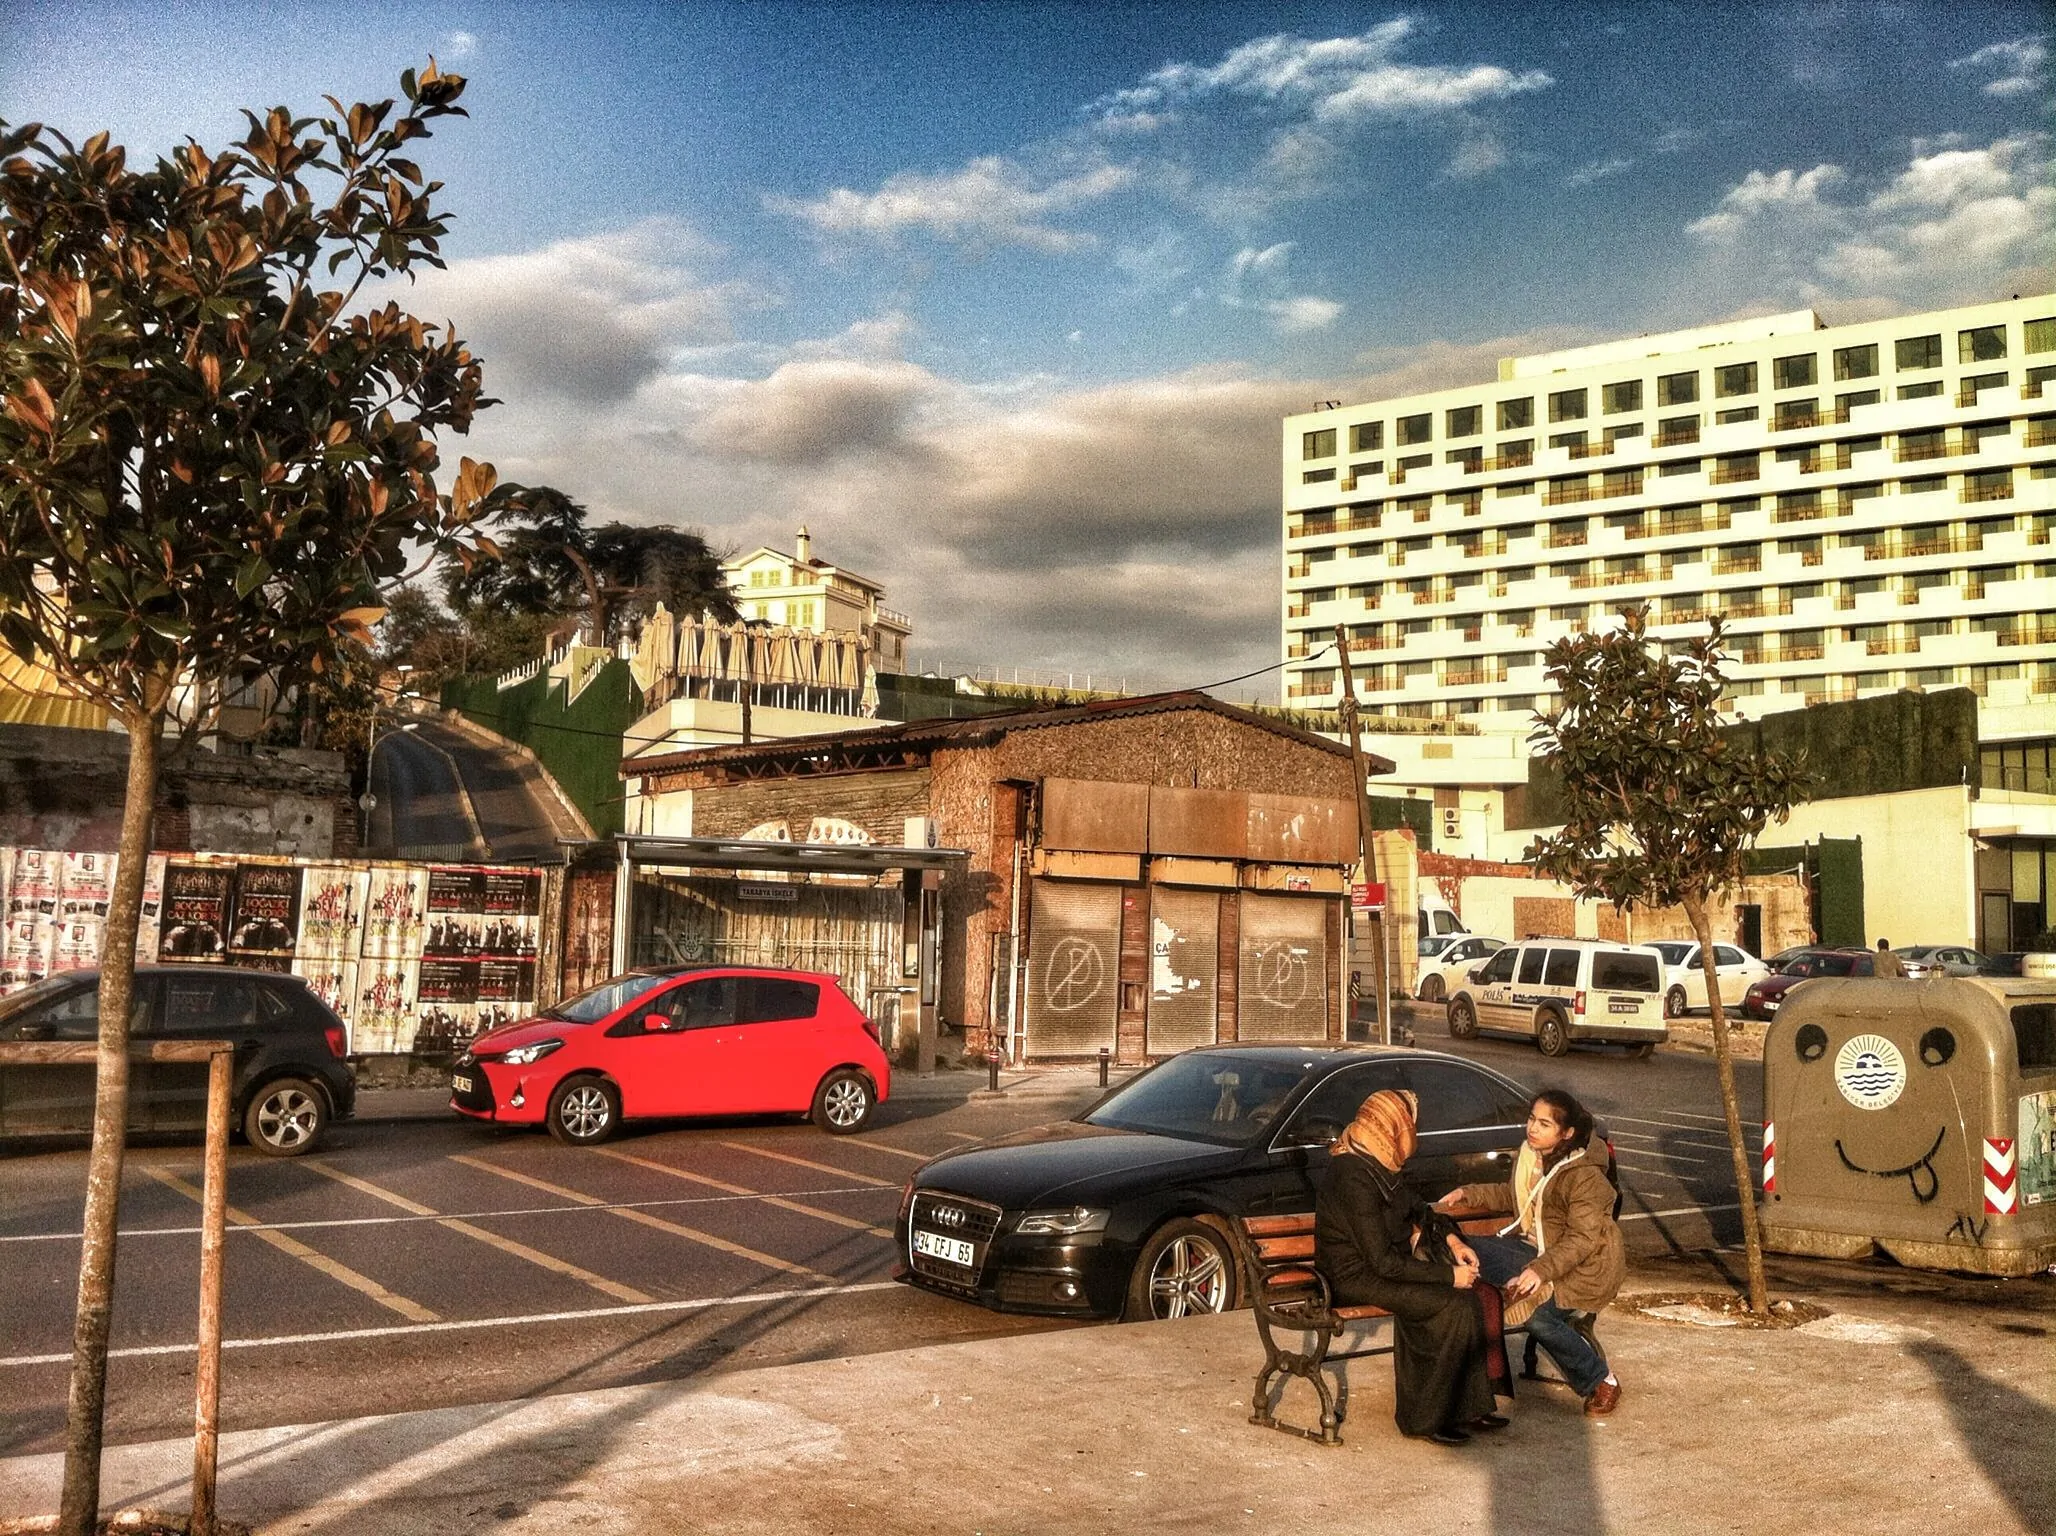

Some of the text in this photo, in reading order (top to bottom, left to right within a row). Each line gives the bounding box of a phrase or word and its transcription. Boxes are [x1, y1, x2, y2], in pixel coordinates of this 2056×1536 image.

[918, 1233, 970, 1262] 34 CFJ 65
